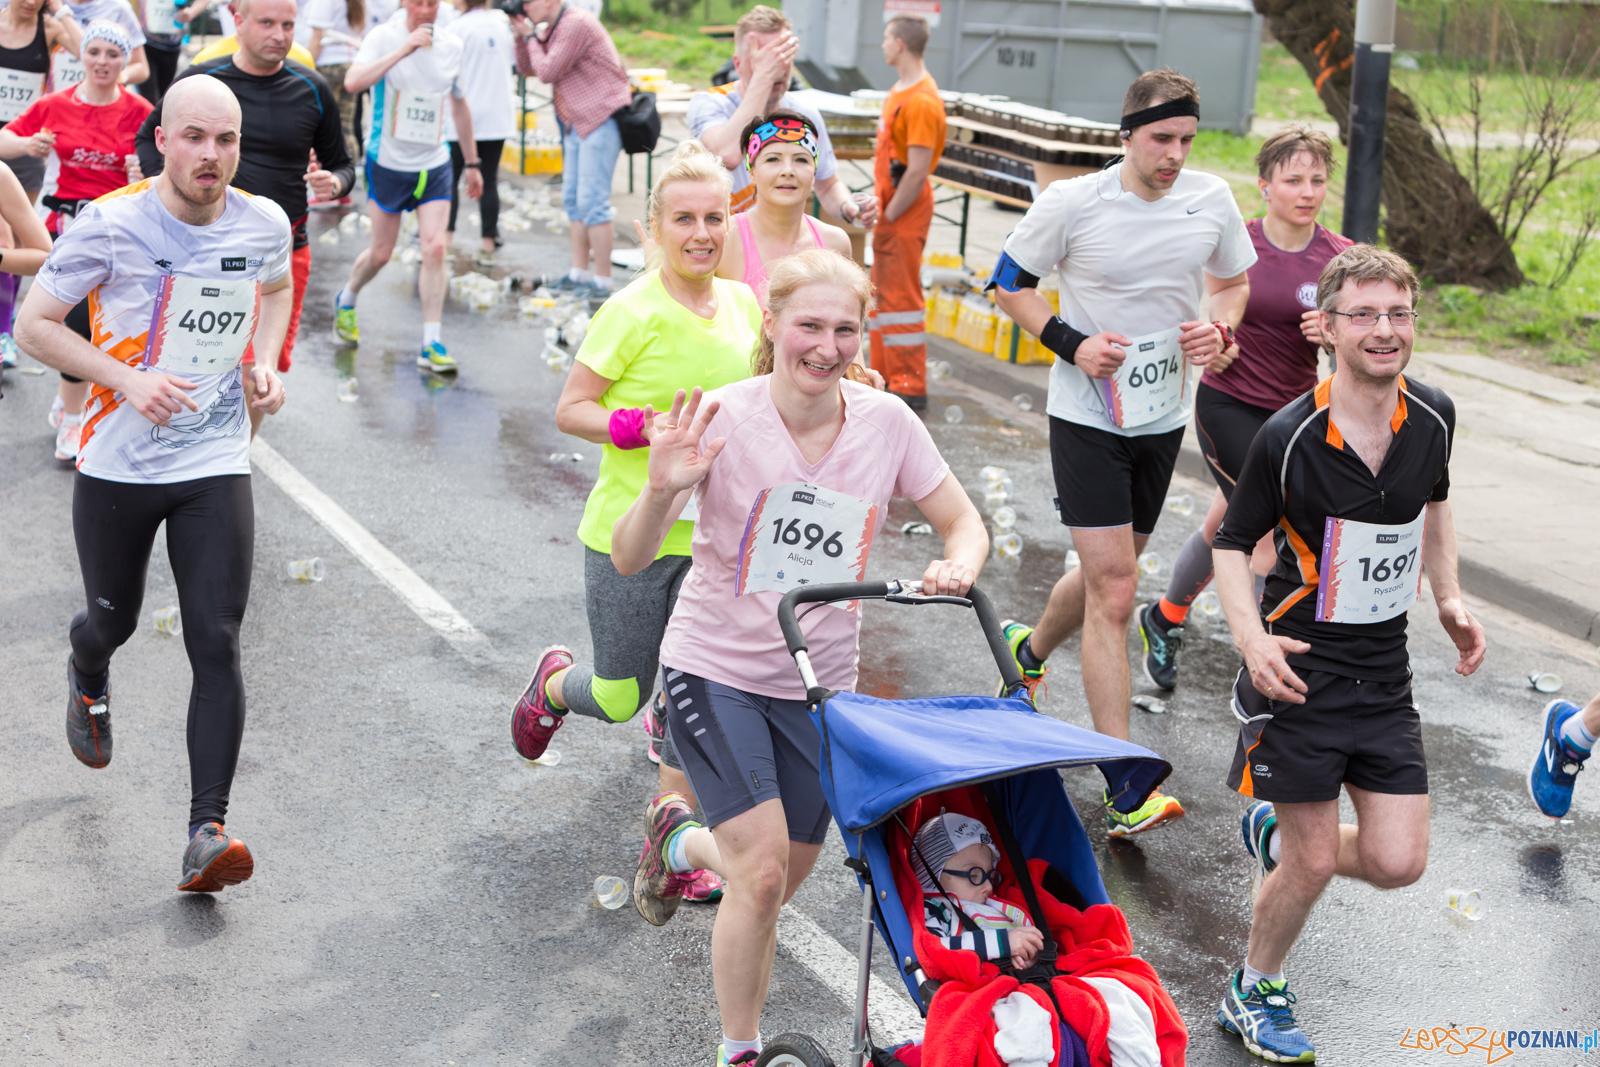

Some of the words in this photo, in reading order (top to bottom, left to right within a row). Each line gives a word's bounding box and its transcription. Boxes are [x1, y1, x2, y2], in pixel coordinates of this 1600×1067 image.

[61, 69, 86, 82] 720
[0, 86, 33, 101] 5137
[406, 107, 435, 123] 1328
[178, 309, 246, 335] 4097
[196, 339, 223, 347] Szymon
[1128, 354, 1178, 388] 6074
[1149, 385, 1167, 396] Marcin
[772, 518, 843, 558] 1696
[787, 552, 813, 566] Alicja
[1358, 546, 1417, 582] 1697
[1374, 583, 1404, 595] Ryszard
